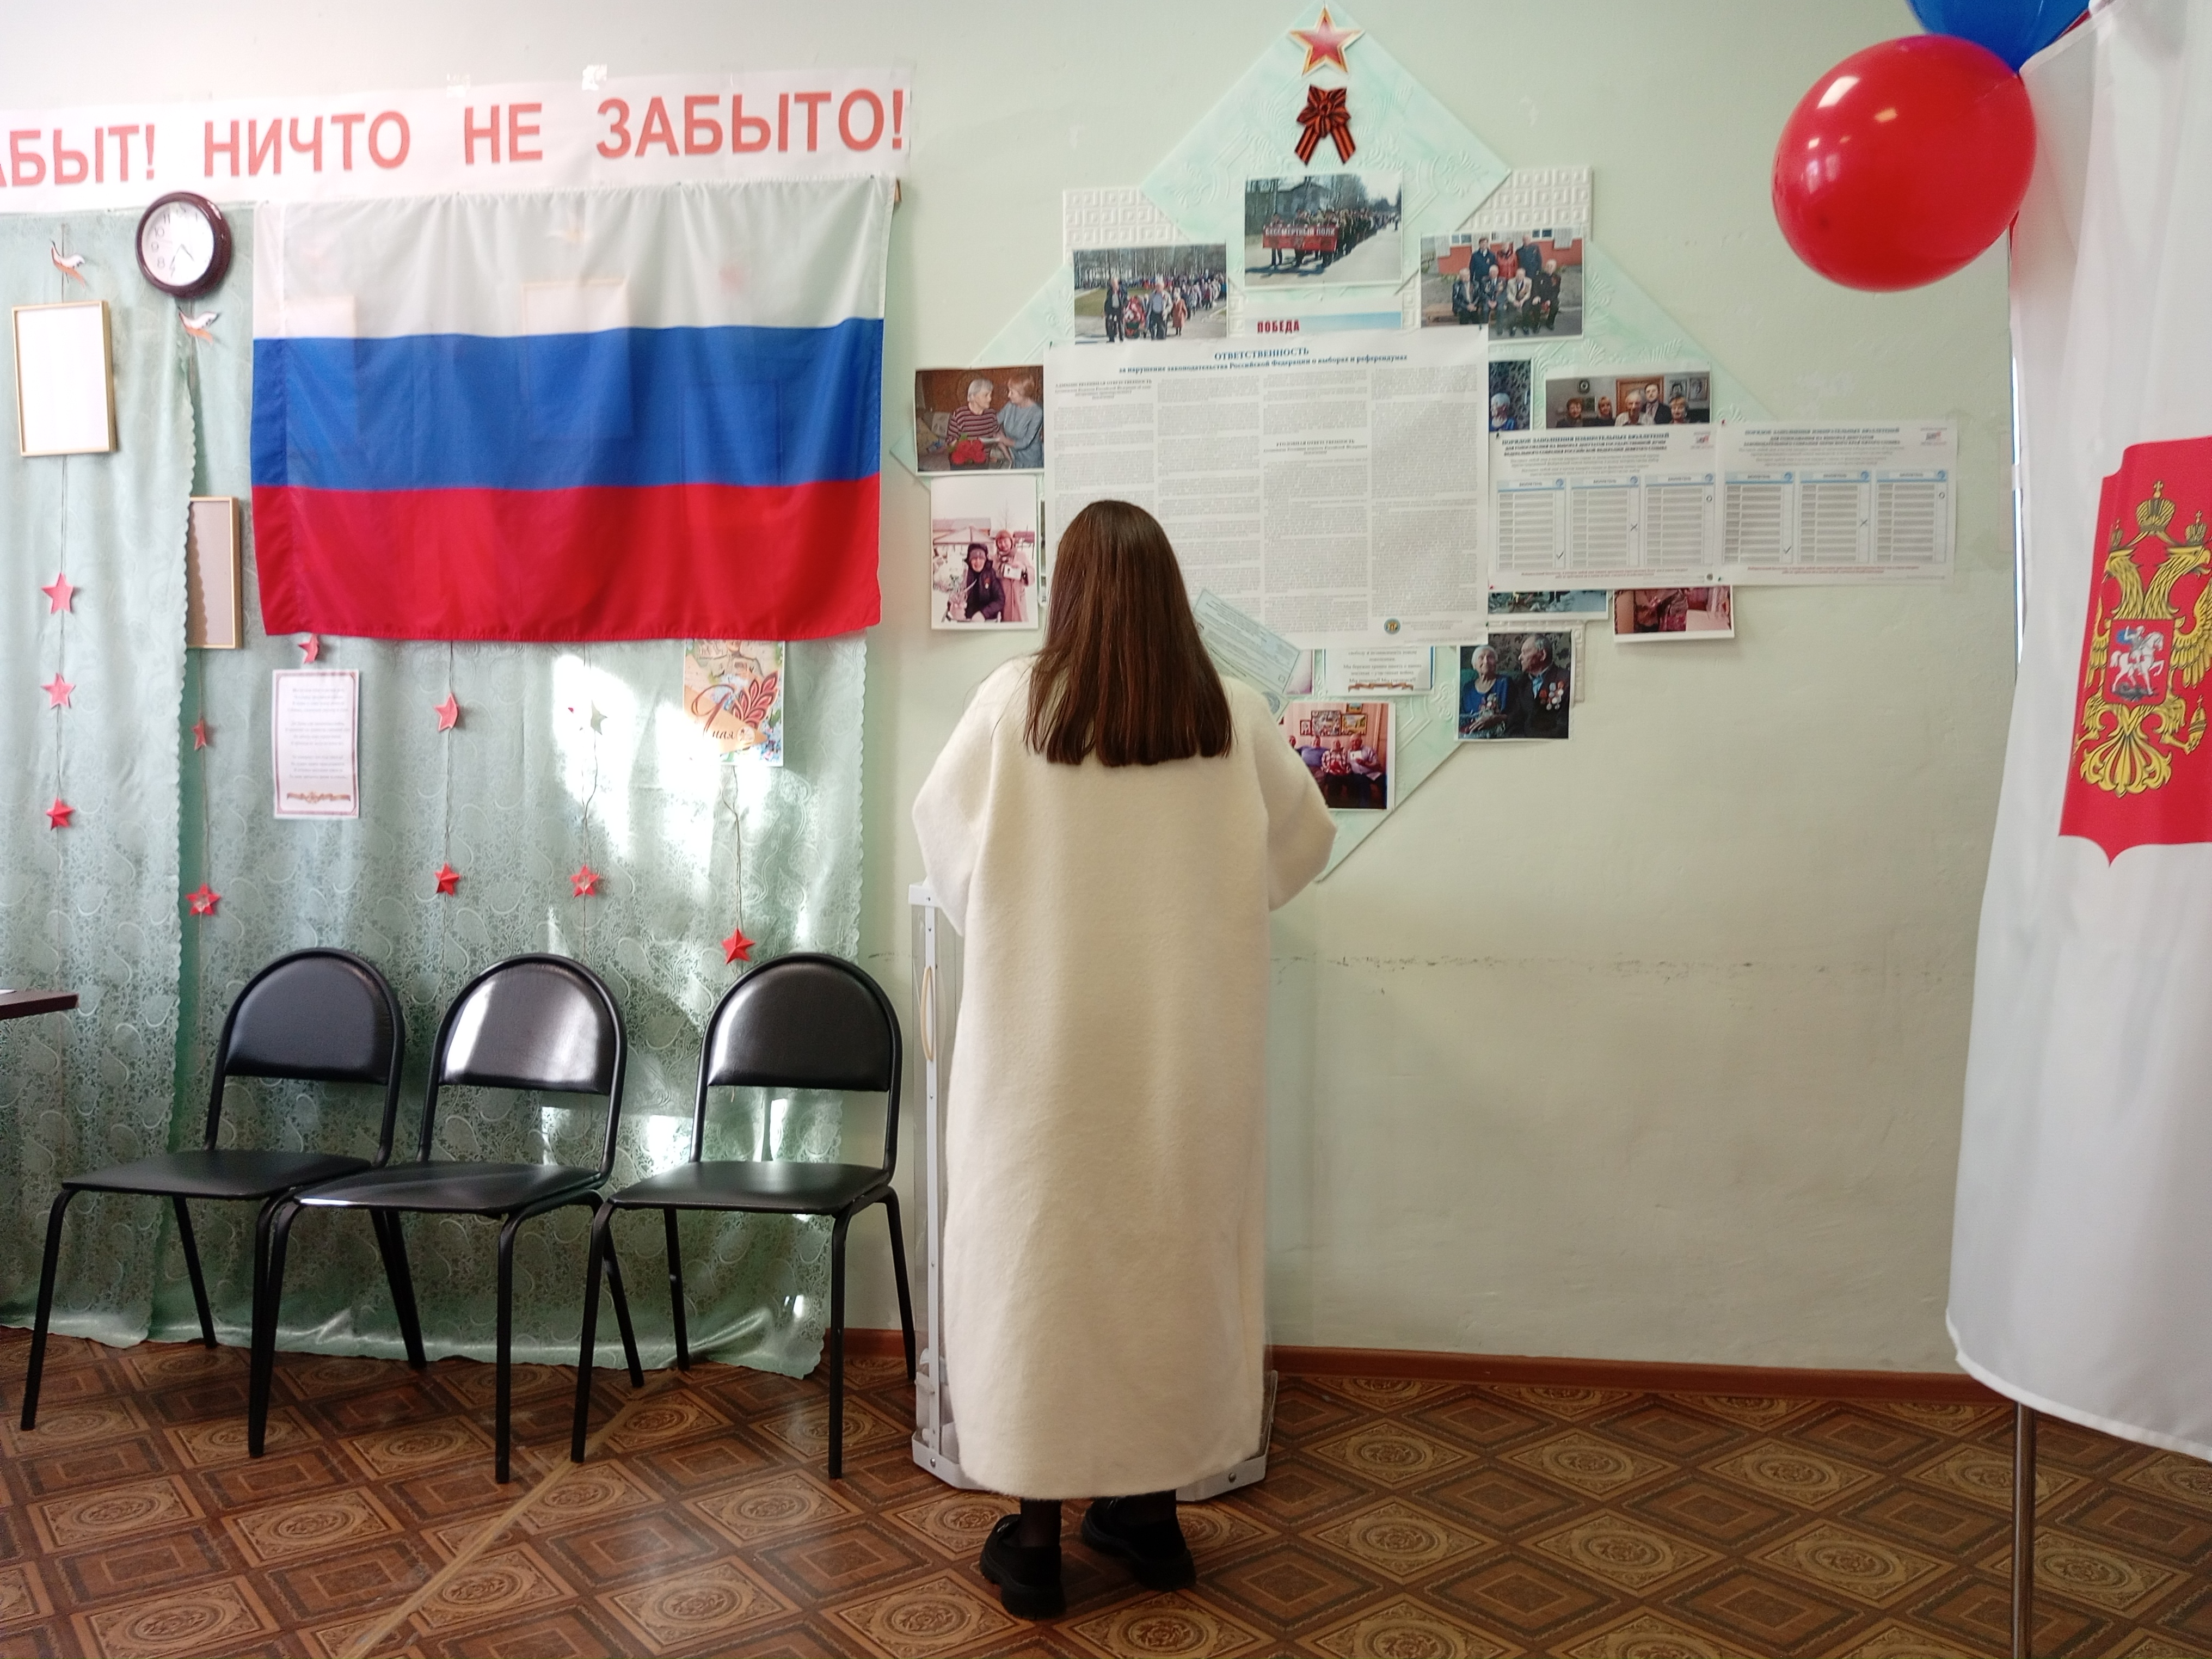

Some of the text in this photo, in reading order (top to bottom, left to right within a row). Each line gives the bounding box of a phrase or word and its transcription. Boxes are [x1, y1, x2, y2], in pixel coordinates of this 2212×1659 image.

[0, 89, 905, 187] БЫТ! НИЧТО НЕ ЗАБЫТО!
[1265, 227, 1335, 236] БЕССМЕРТНЫЙ ПОЛК
[1257, 319, 1300, 334] ПОБЕДА
[1214, 347, 1309, 361] ОТВЕТСТВЕННОСТЬ
[1127, 366, 1166, 375] нарушение
[1230, 360, 1270, 369] Российской
[1271, 358, 1310, 367] Федерации
[1318, 356, 1348, 365] выборах
[1356, 354, 1408, 365] референдумах
